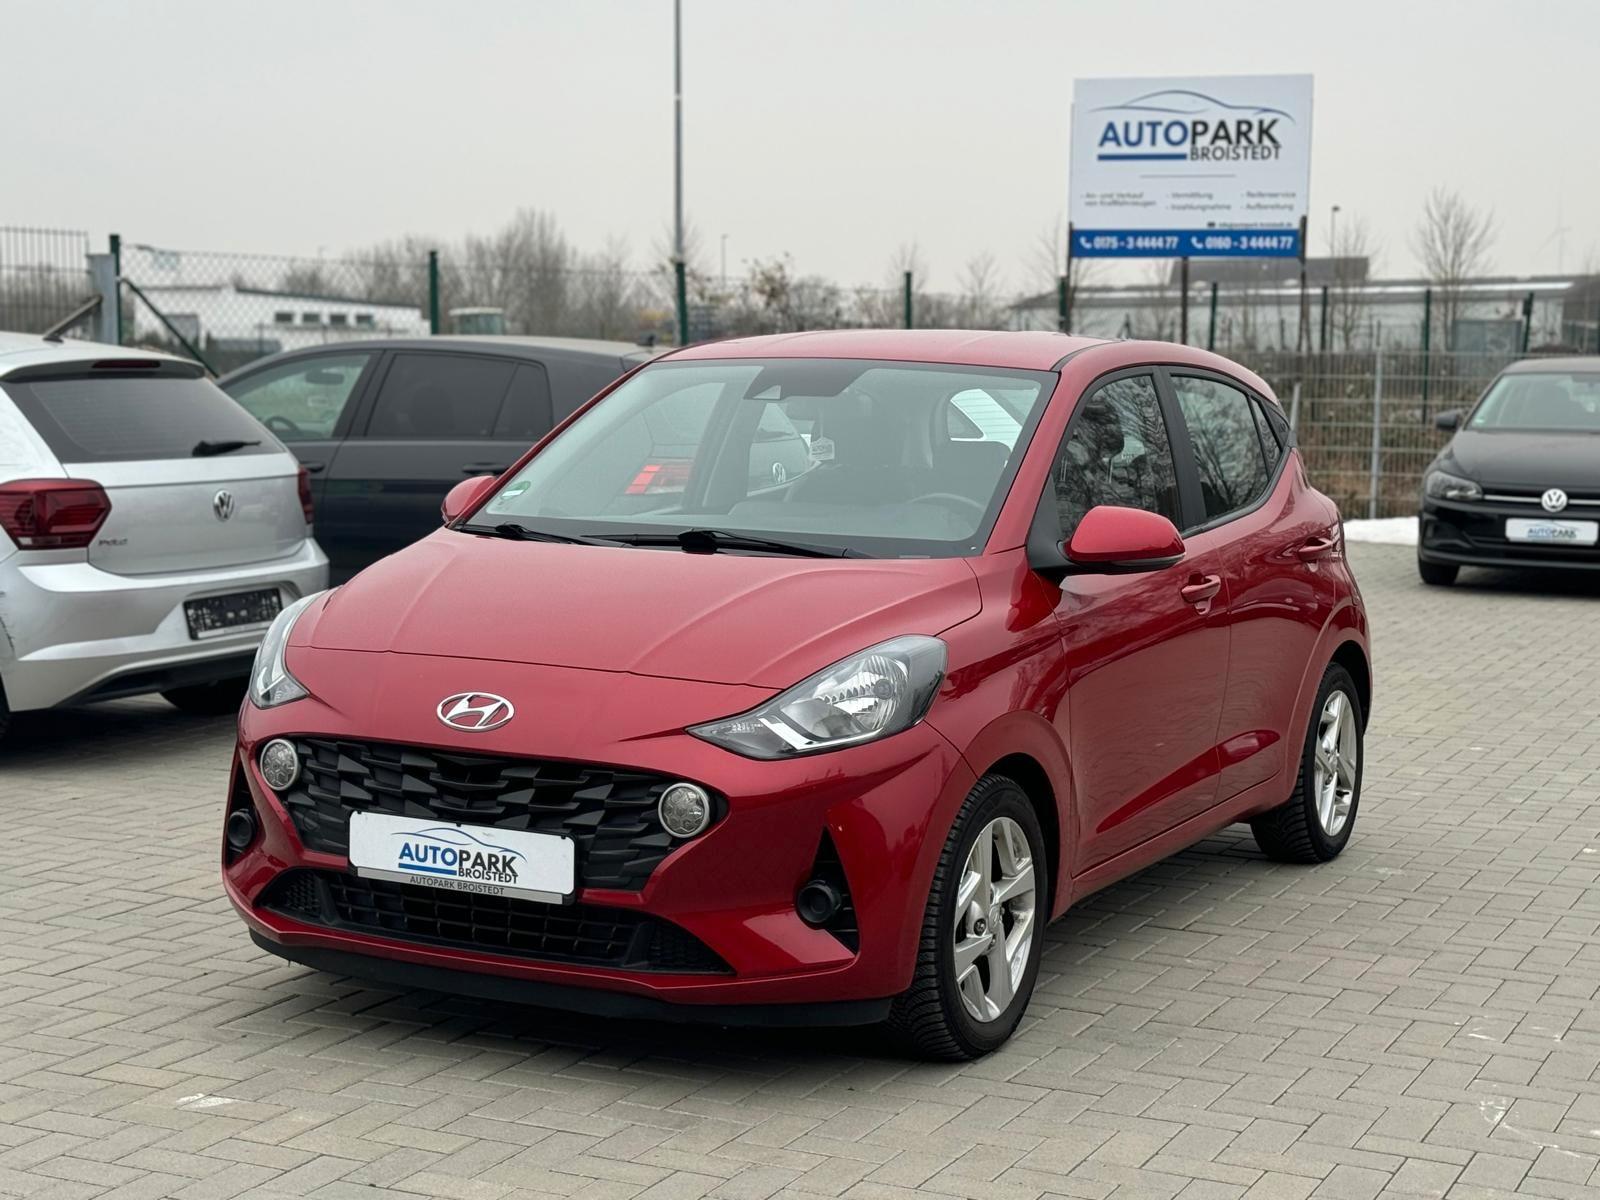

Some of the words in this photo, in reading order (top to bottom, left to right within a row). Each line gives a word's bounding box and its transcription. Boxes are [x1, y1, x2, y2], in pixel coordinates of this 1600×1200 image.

[1098, 119, 1280, 147] AUTOPARK
[1190, 145, 1281, 161] BROISTEDT
[398, 842, 519, 876] AUTOPARK
[409, 875, 455, 890] AUTOPARK
[456, 880, 505, 896] BROISTEDT
[458, 867, 519, 885] BROISTEDT
